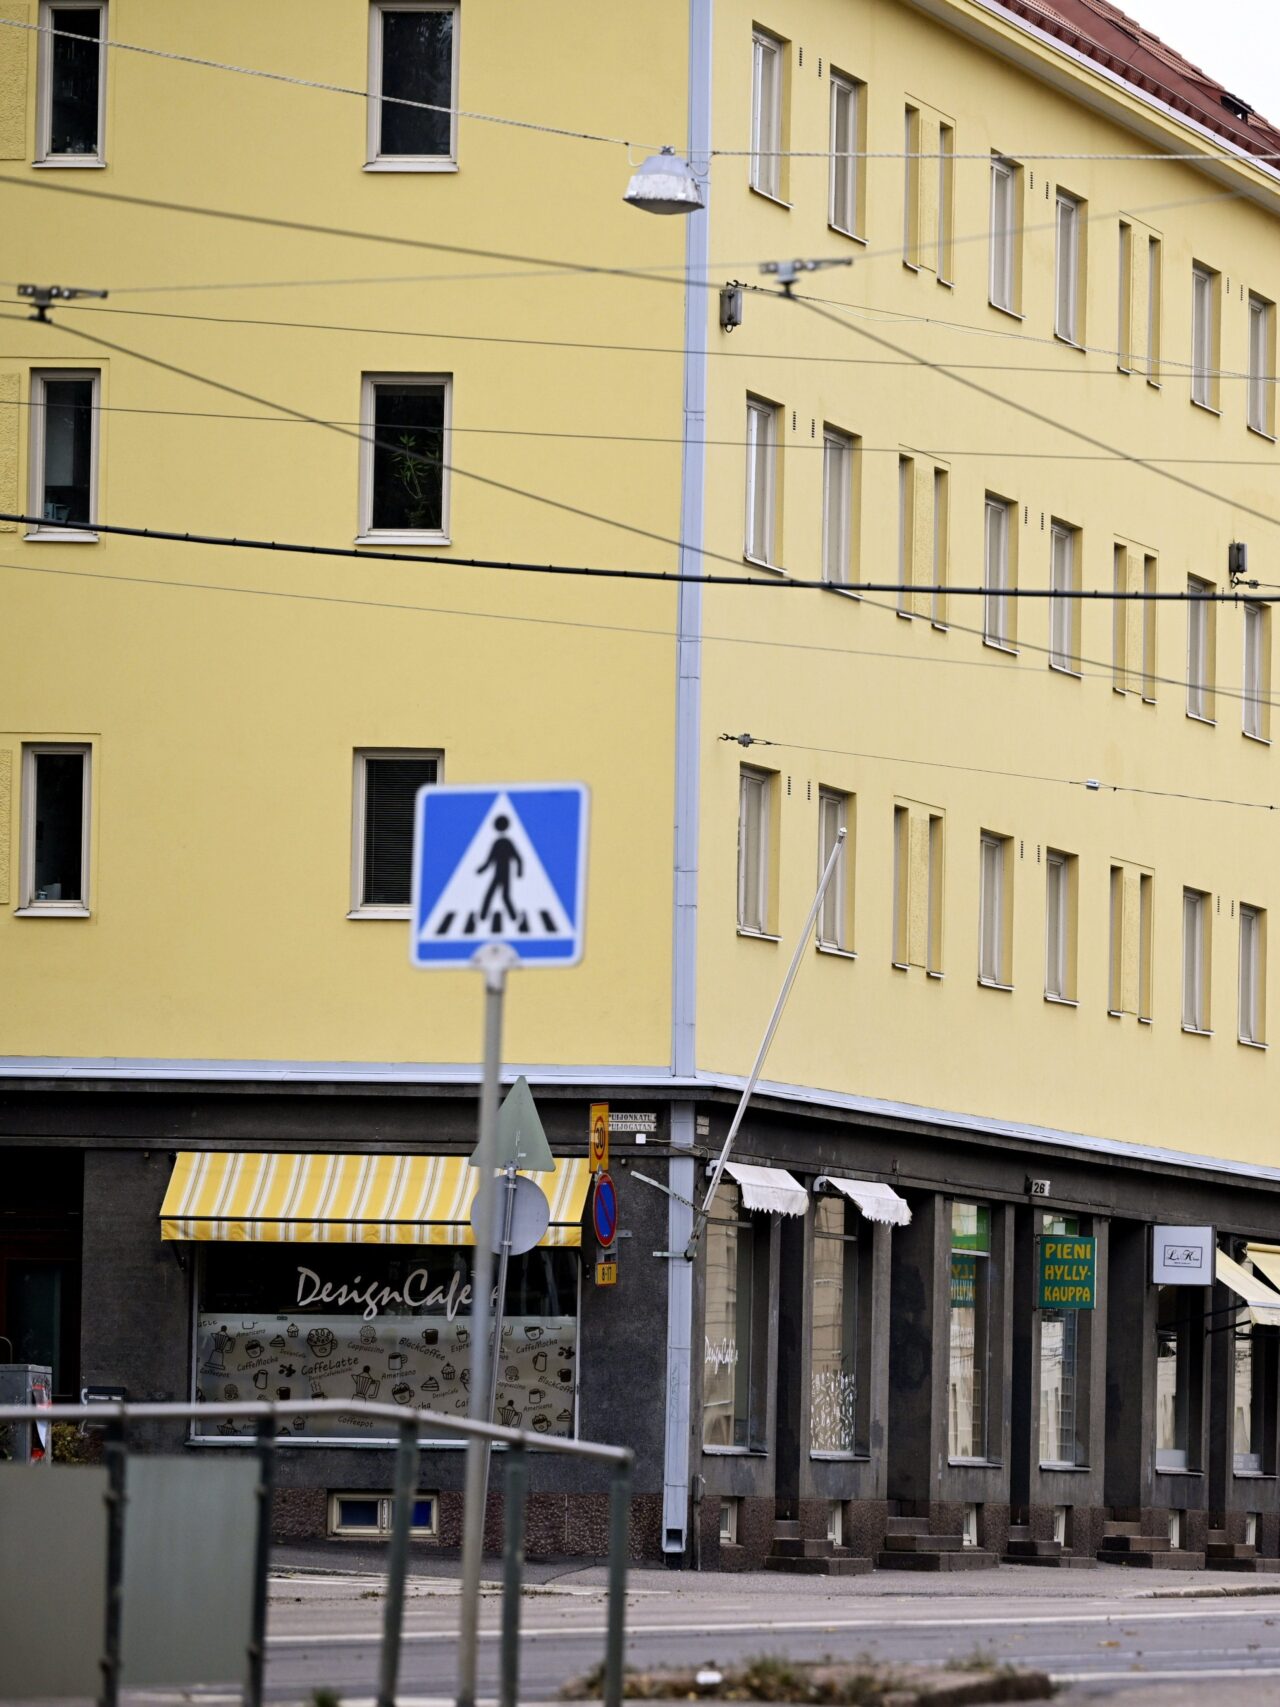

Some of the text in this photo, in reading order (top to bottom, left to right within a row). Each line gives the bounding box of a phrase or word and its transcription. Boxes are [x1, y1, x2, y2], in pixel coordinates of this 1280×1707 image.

[596, 1126, 604, 1149] 30
[1034, 1182, 1045, 1194] 26
[1045, 1243, 1091, 1259] PIENI
[1044, 1264, 1091, 1280] HYLLY-
[1044, 1286, 1091, 1302] KAUPPA
[399, 1337, 446, 1361] BlackCoffee
[516, 1338, 558, 1354] CaffeMocha
[237, 1356, 279, 1372] CaffeMocha
[301, 1356, 360, 1375] CaffeLatte
[381, 1369, 417, 1380] Americano
[337, 1415, 375, 1429] Coffeepot
